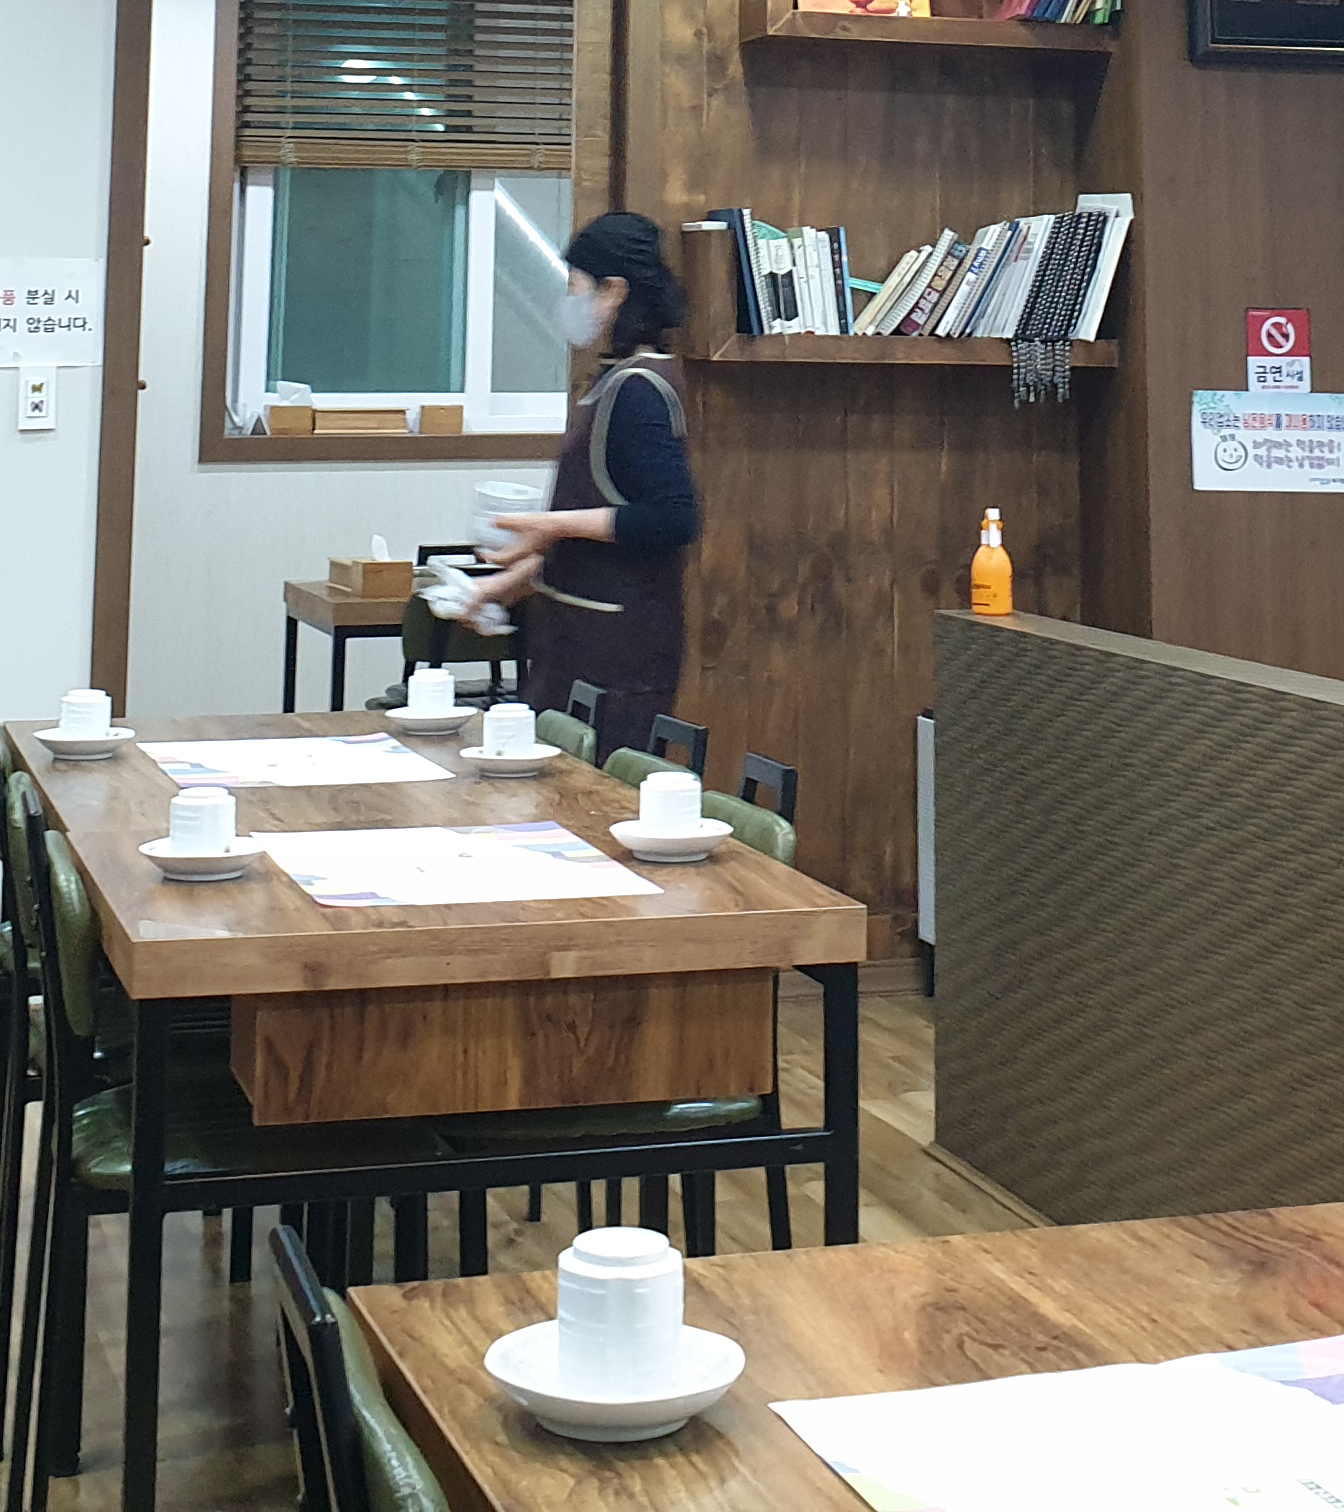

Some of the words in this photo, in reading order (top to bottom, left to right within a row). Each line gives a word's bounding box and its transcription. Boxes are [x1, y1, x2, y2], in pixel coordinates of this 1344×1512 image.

[26, 289, 55, 305] 분실
[64, 289, 80, 304] 시
[26, 316, 93, 333] 않습니다.
[1254, 364, 1284, 384] 금연
